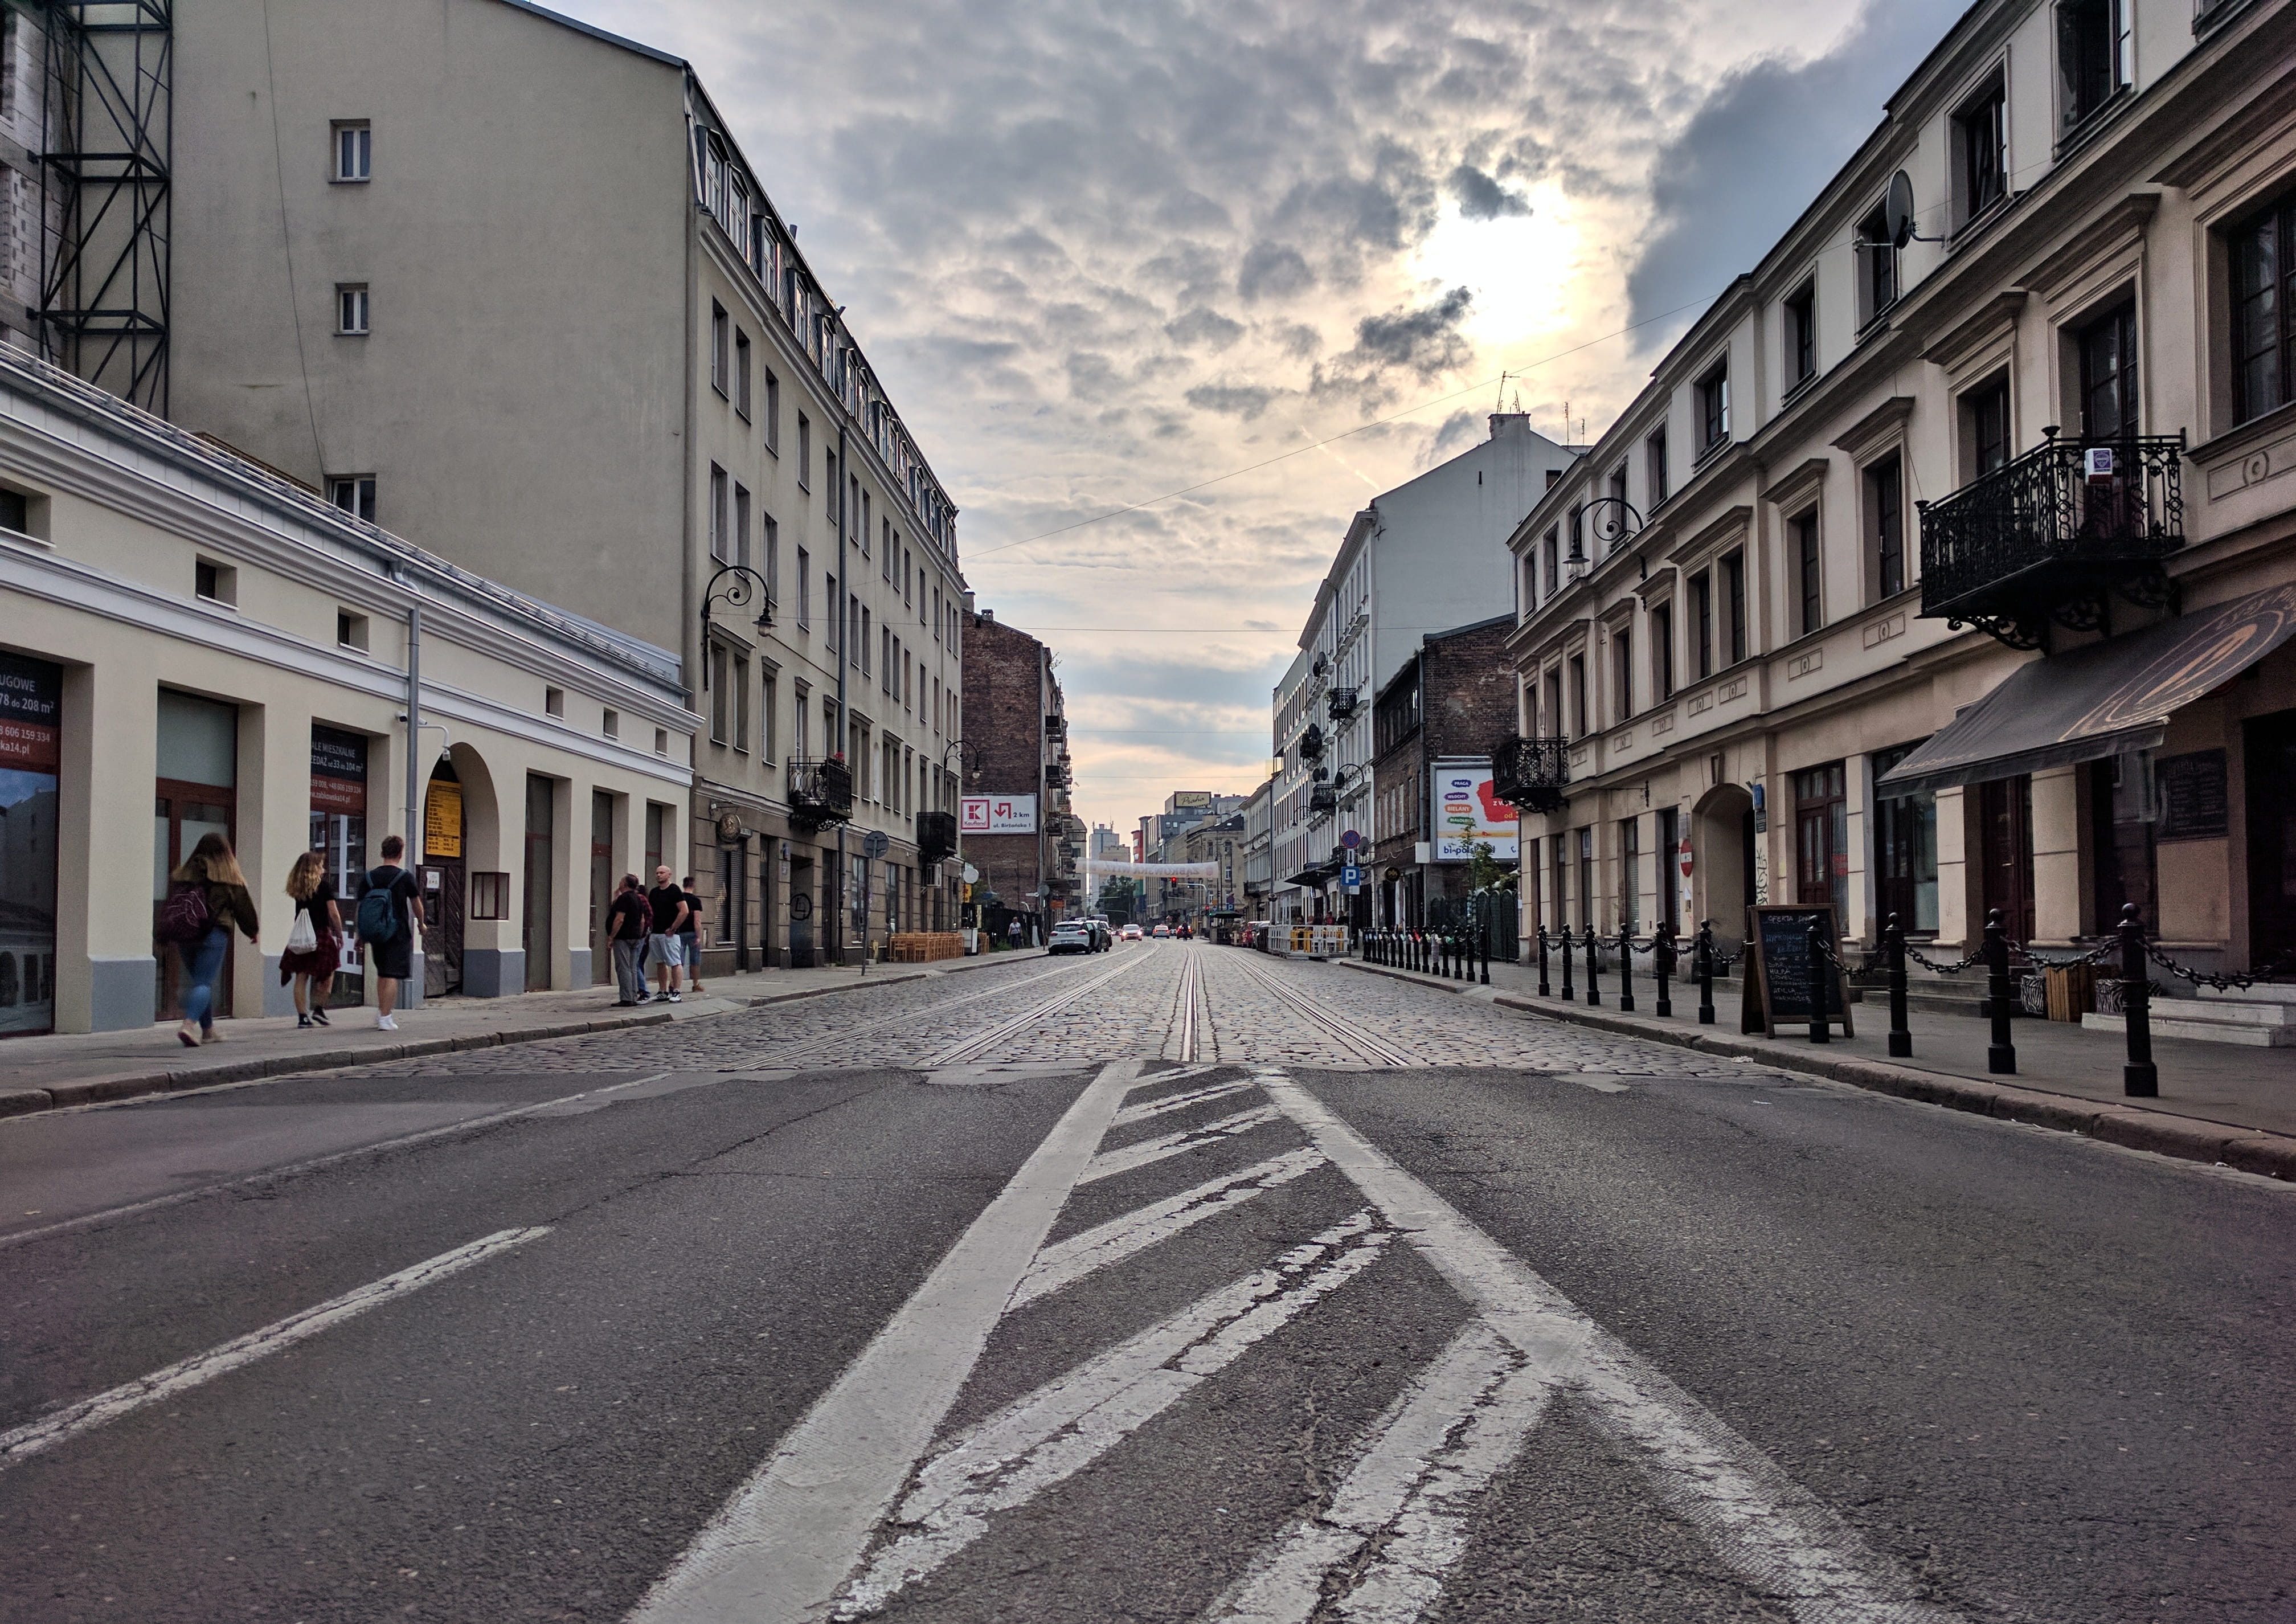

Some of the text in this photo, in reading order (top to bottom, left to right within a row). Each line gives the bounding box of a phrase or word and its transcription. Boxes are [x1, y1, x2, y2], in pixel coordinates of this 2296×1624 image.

[11, 699, 20, 708] do
[22, 698, 39, 711] 208
[5, 727, 19, 738] 606
[21, 729, 35, 740] 159
[36, 731, 50, 742] 334
[322, 743, 355, 758] MIESZKALNE
[333, 759, 340, 769] 33
[1345, 869, 1356, 883] P
